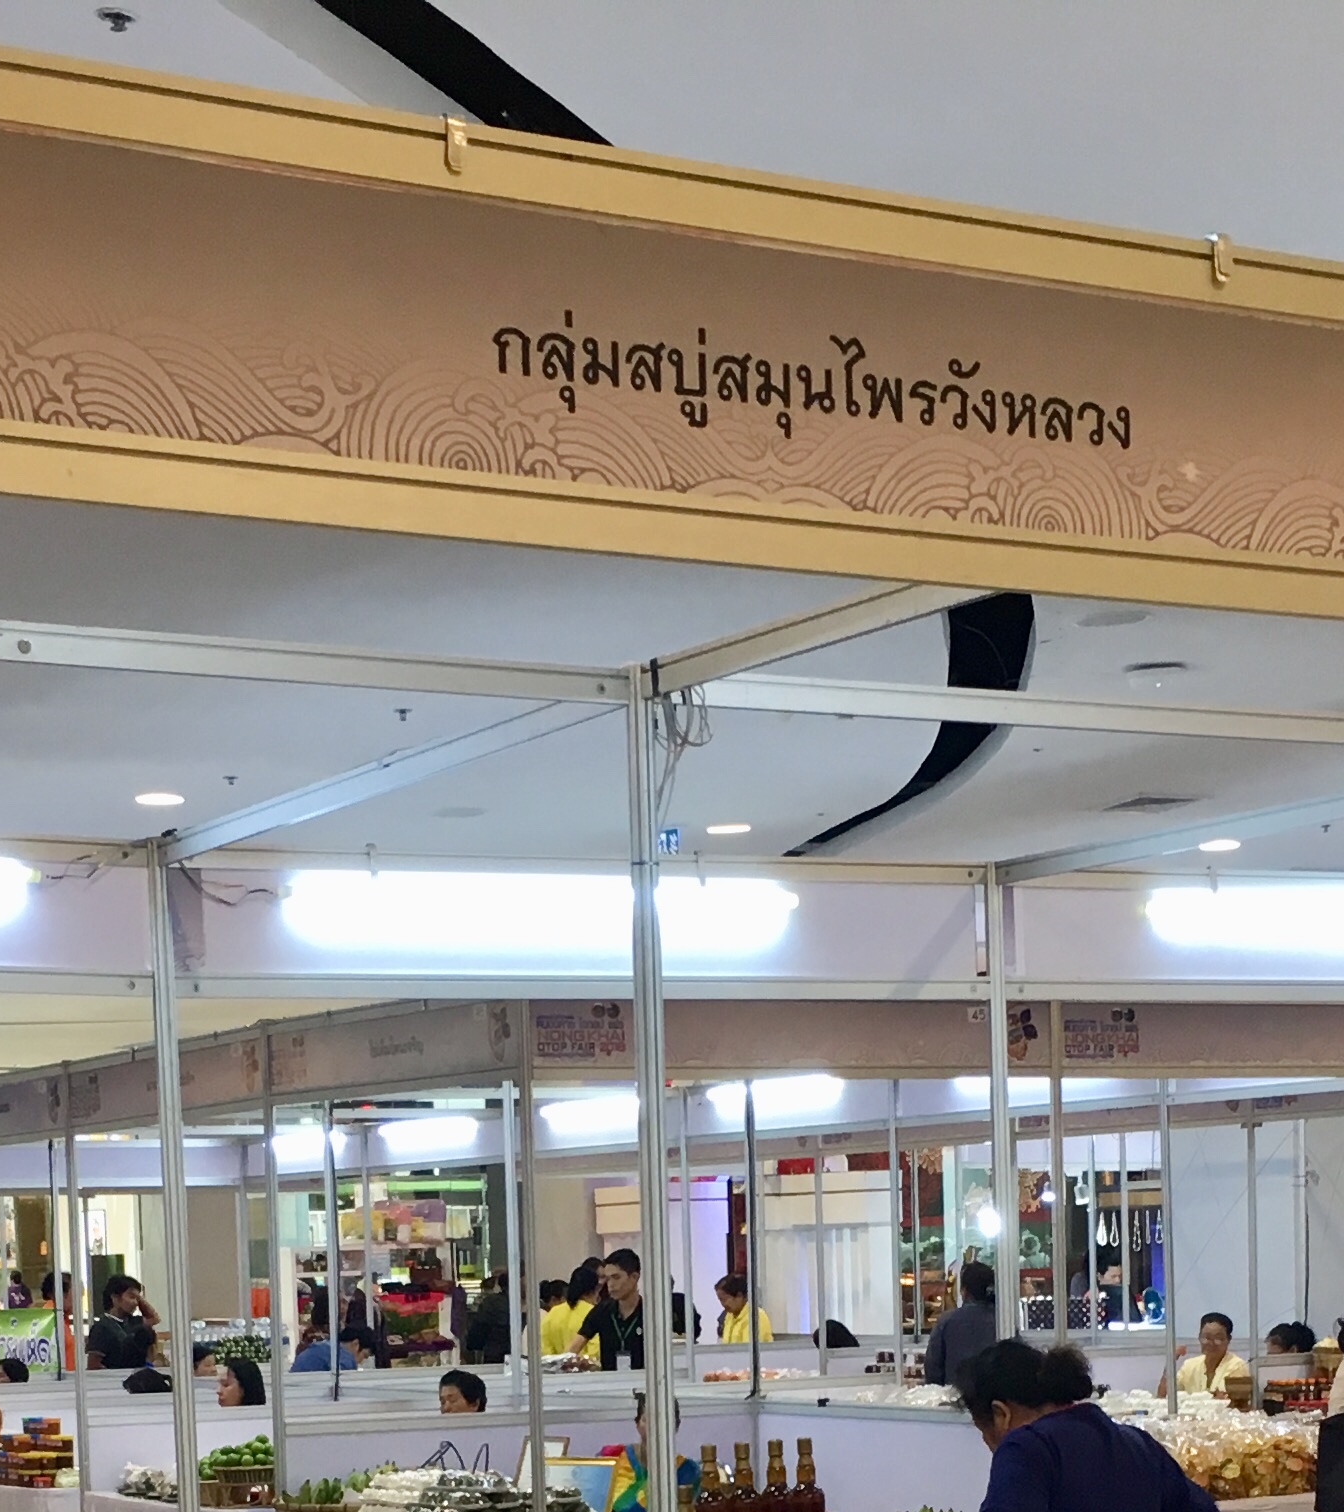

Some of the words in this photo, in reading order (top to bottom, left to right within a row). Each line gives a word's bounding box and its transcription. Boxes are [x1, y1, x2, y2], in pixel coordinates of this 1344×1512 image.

[492, 310, 1132, 451] กลุ่มสบู่สมุนไพรวังหลวง
[971, 1009, 986, 1021] 45
